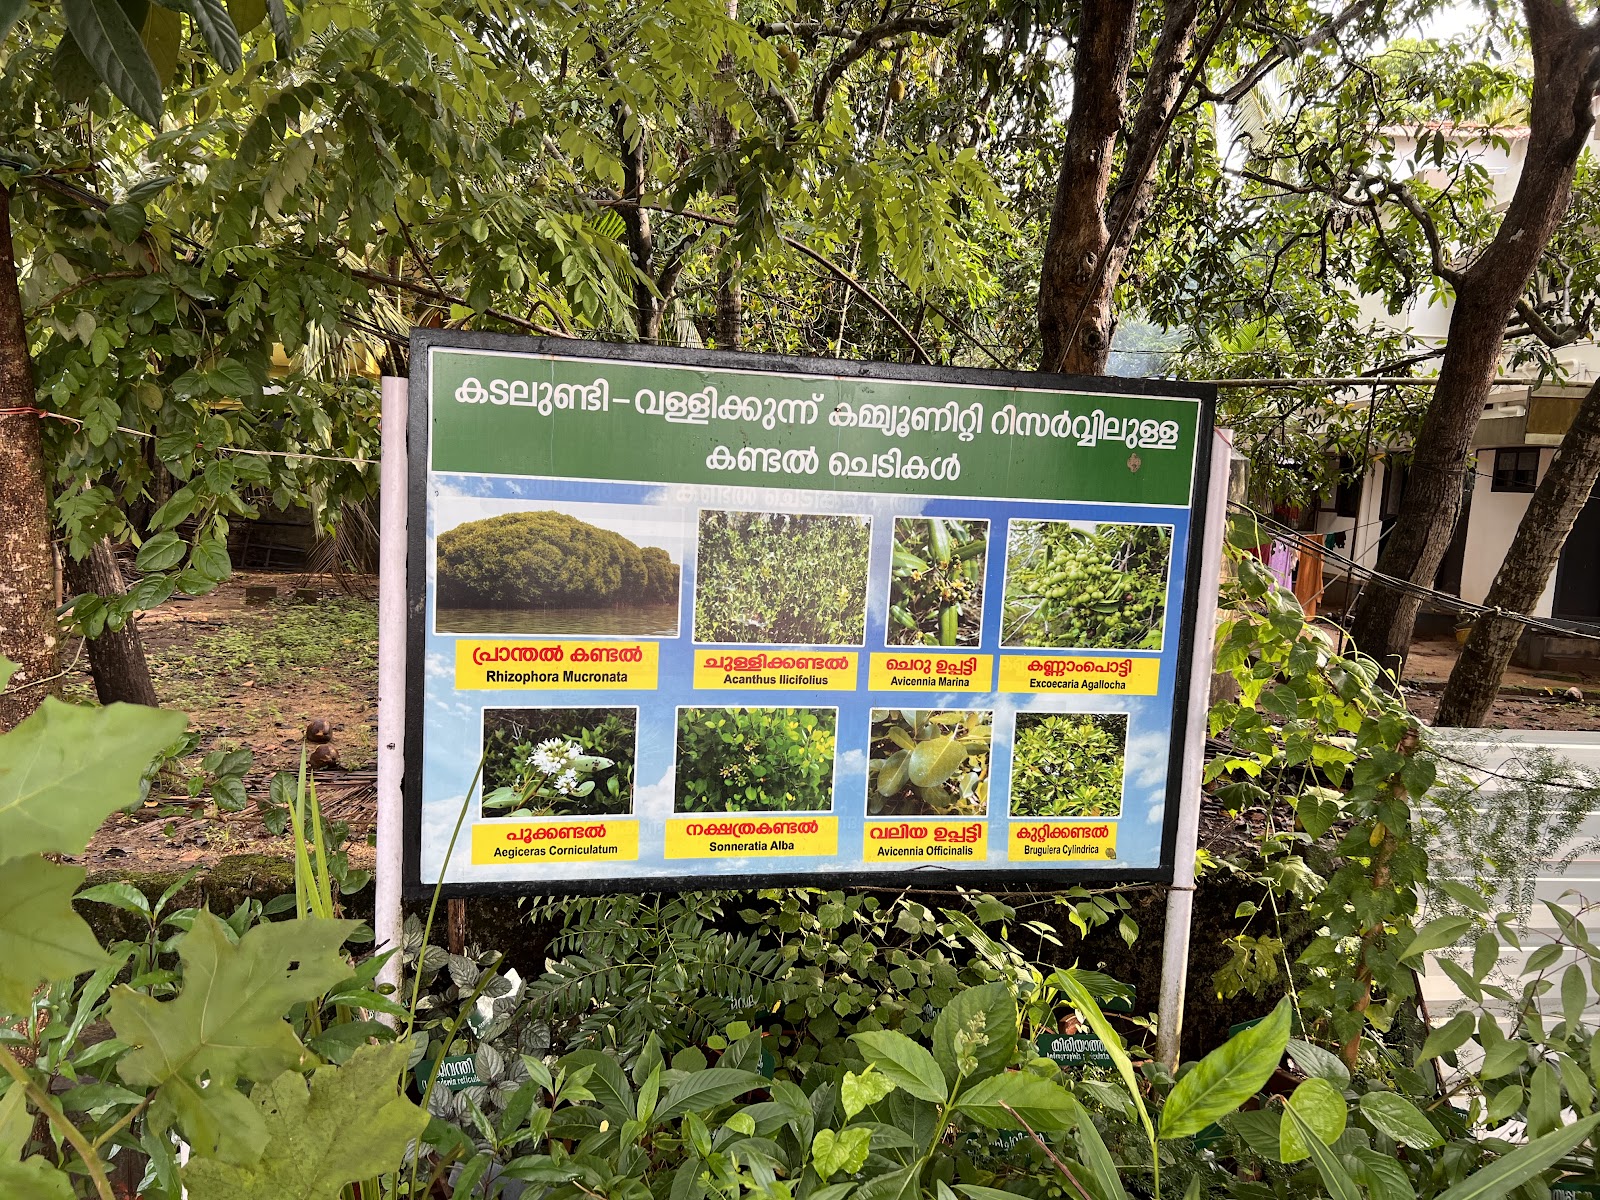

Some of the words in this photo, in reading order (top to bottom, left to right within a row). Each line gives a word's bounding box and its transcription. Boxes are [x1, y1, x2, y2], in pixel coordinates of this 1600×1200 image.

[705, 444, 820, 475] കണ്ടൽ
[828, 446, 961, 481] ചെടികൾ
[569, 645, 643, 663] കണ്ടൽ
[886, 658, 932, 675] ചെറു
[935, 656, 977, 676] ഉപ്പട്ടി
[486, 670, 559, 685] Rhizophora
[562, 670, 628, 683] Mucronata
[723, 673, 776, 685] Acanthus
[779, 674, 829, 685] Ilicifolius
[890, 675, 936, 687] Avicennia
[938, 676, 970, 687] Marina
[1029, 678, 1079, 689] Excoecaria
[1080, 679, 1126, 691] Agallocha
[869, 823, 928, 840] വലിയ
[933, 823, 982, 844] ഉപ്പട്ടി
[493, 846, 546, 860] Aegiceras
[549, 844, 618, 856] Corniculatum
[709, 840, 768, 852] Sonneratia
[770, 839, 795, 851] Alba
[877, 845, 924, 857] Avicennia
[925, 845, 973, 856] Officinalis
[1024, 844, 1061, 857] Bruguiera
[1062, 844, 1099, 857] Cylindrica
